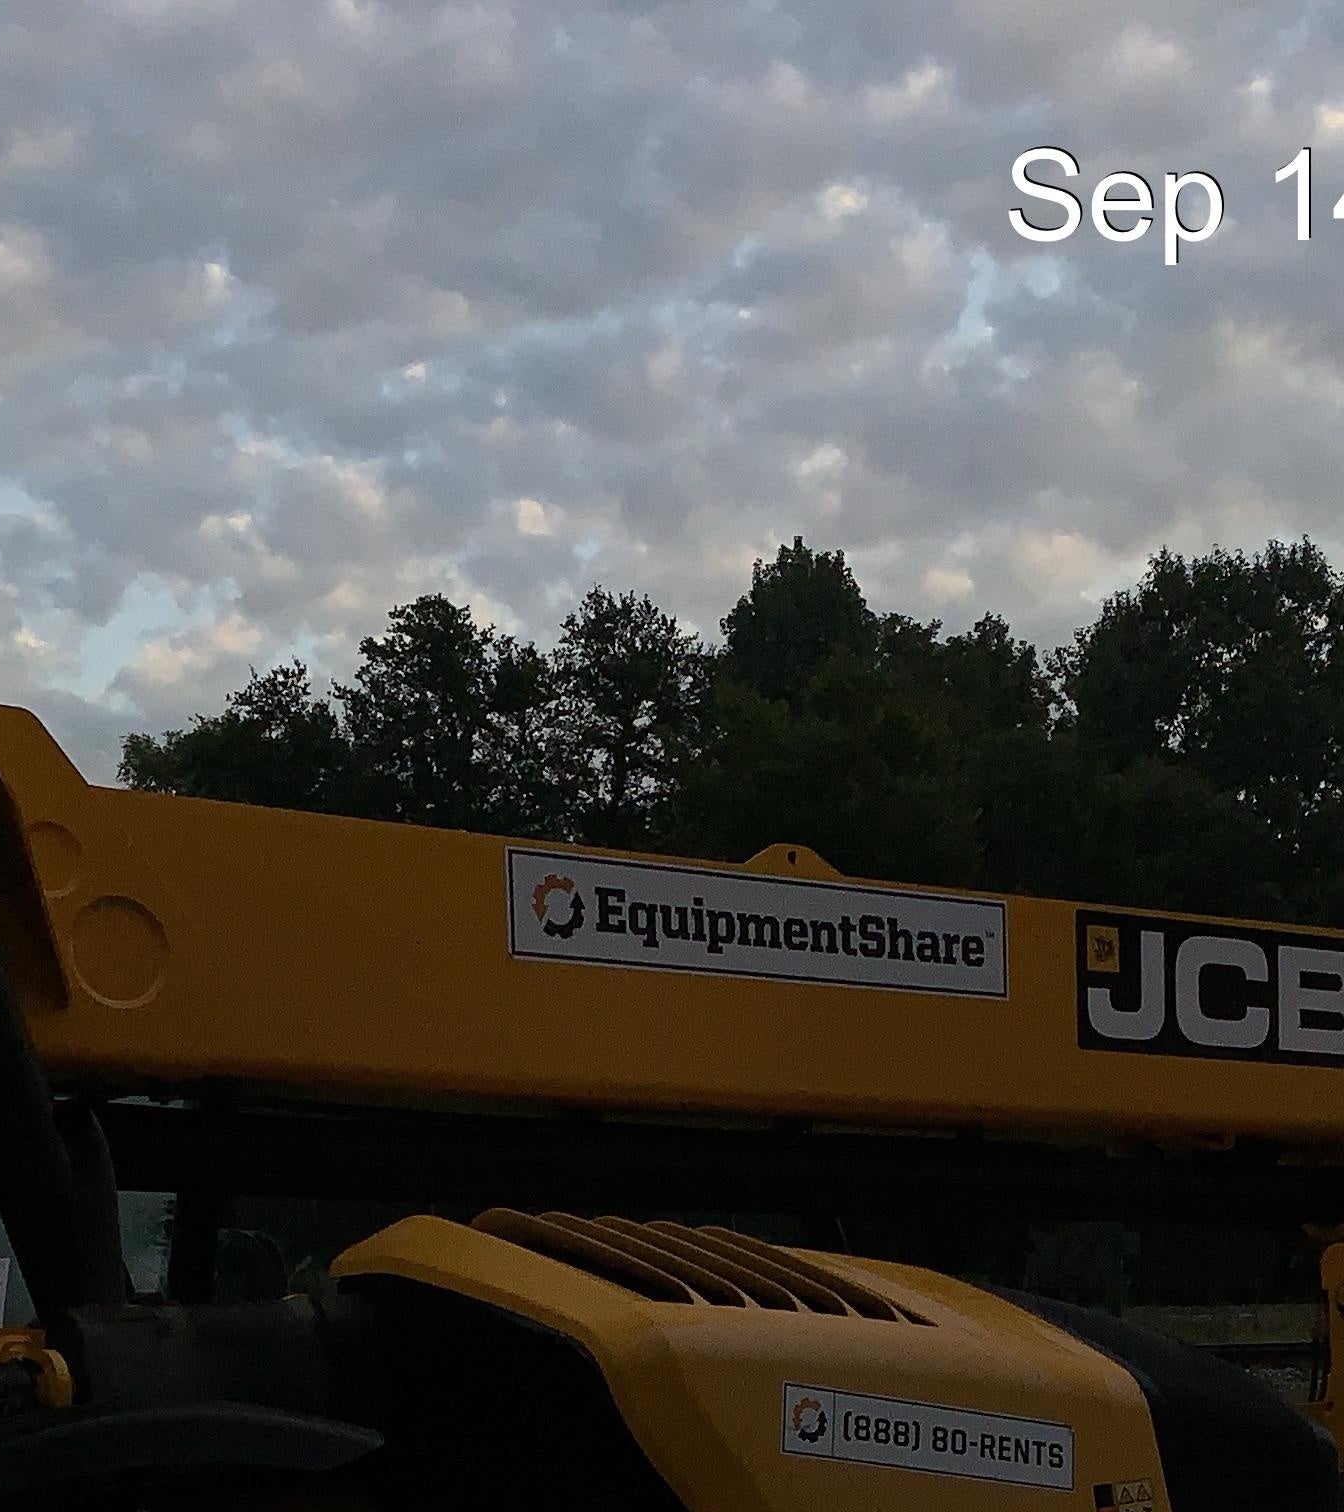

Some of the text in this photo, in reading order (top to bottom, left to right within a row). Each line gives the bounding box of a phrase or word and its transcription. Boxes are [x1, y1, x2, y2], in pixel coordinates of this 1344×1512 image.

[594, 886, 986, 967] EquipmentShare
[843, 1410, 1065, 1469] (888) 80-RENTS
